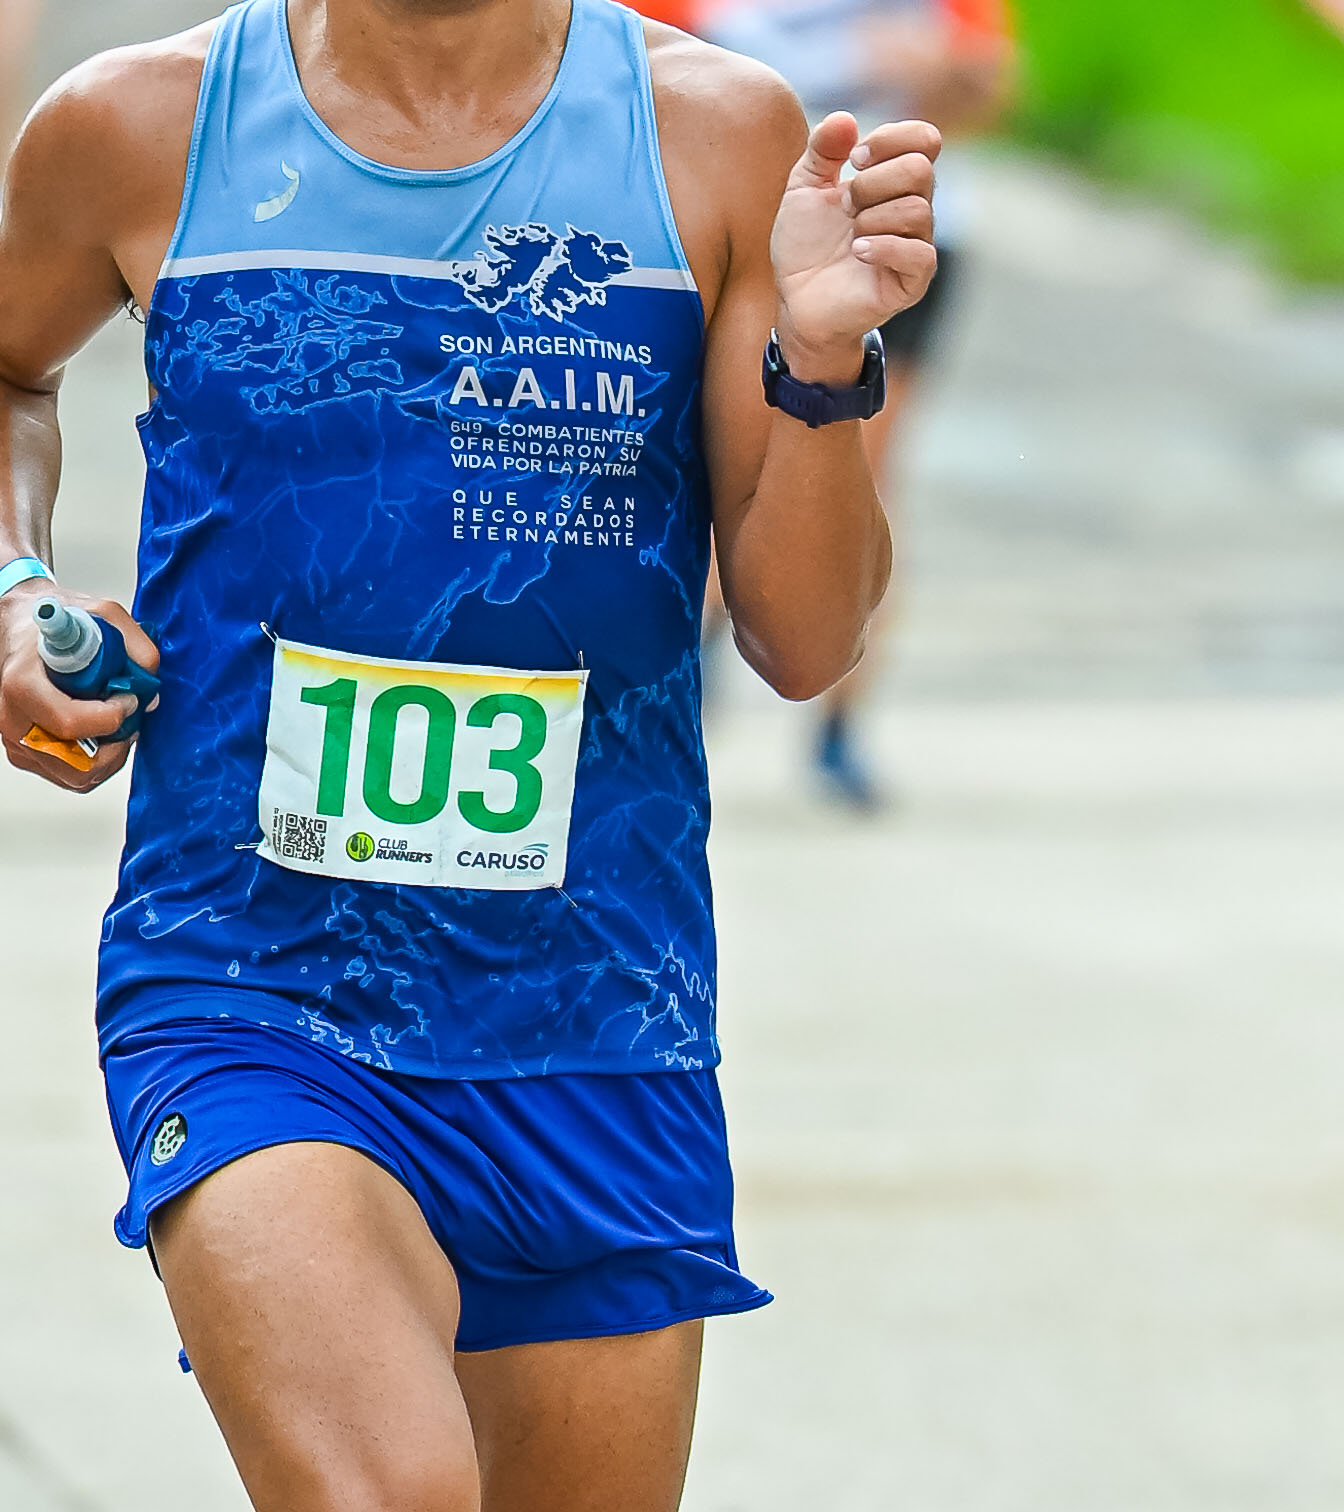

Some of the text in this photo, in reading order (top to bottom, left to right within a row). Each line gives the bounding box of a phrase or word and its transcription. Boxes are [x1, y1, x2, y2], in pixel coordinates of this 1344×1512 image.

[439, 334, 653, 365] SON ARGENTINAS
[449, 365, 646, 418] A.A.I.M.
[450, 421, 645, 446] 649 COMBATIENTES
[450, 436, 641, 462] OFRENDARON SU
[450, 453, 638, 477] VIDA POR LA PATRIA
[452, 489, 636, 511] QUE SEAN
[453, 507, 635, 529] RECORDADOS
[453, 524, 635, 547] ETERNAMENTE
[300, 677, 548, 835] 103
[378, 837, 408, 850] CLUB
[375, 848, 434, 864] RUNNER'S
[456, 849, 546, 871] CARUSO
